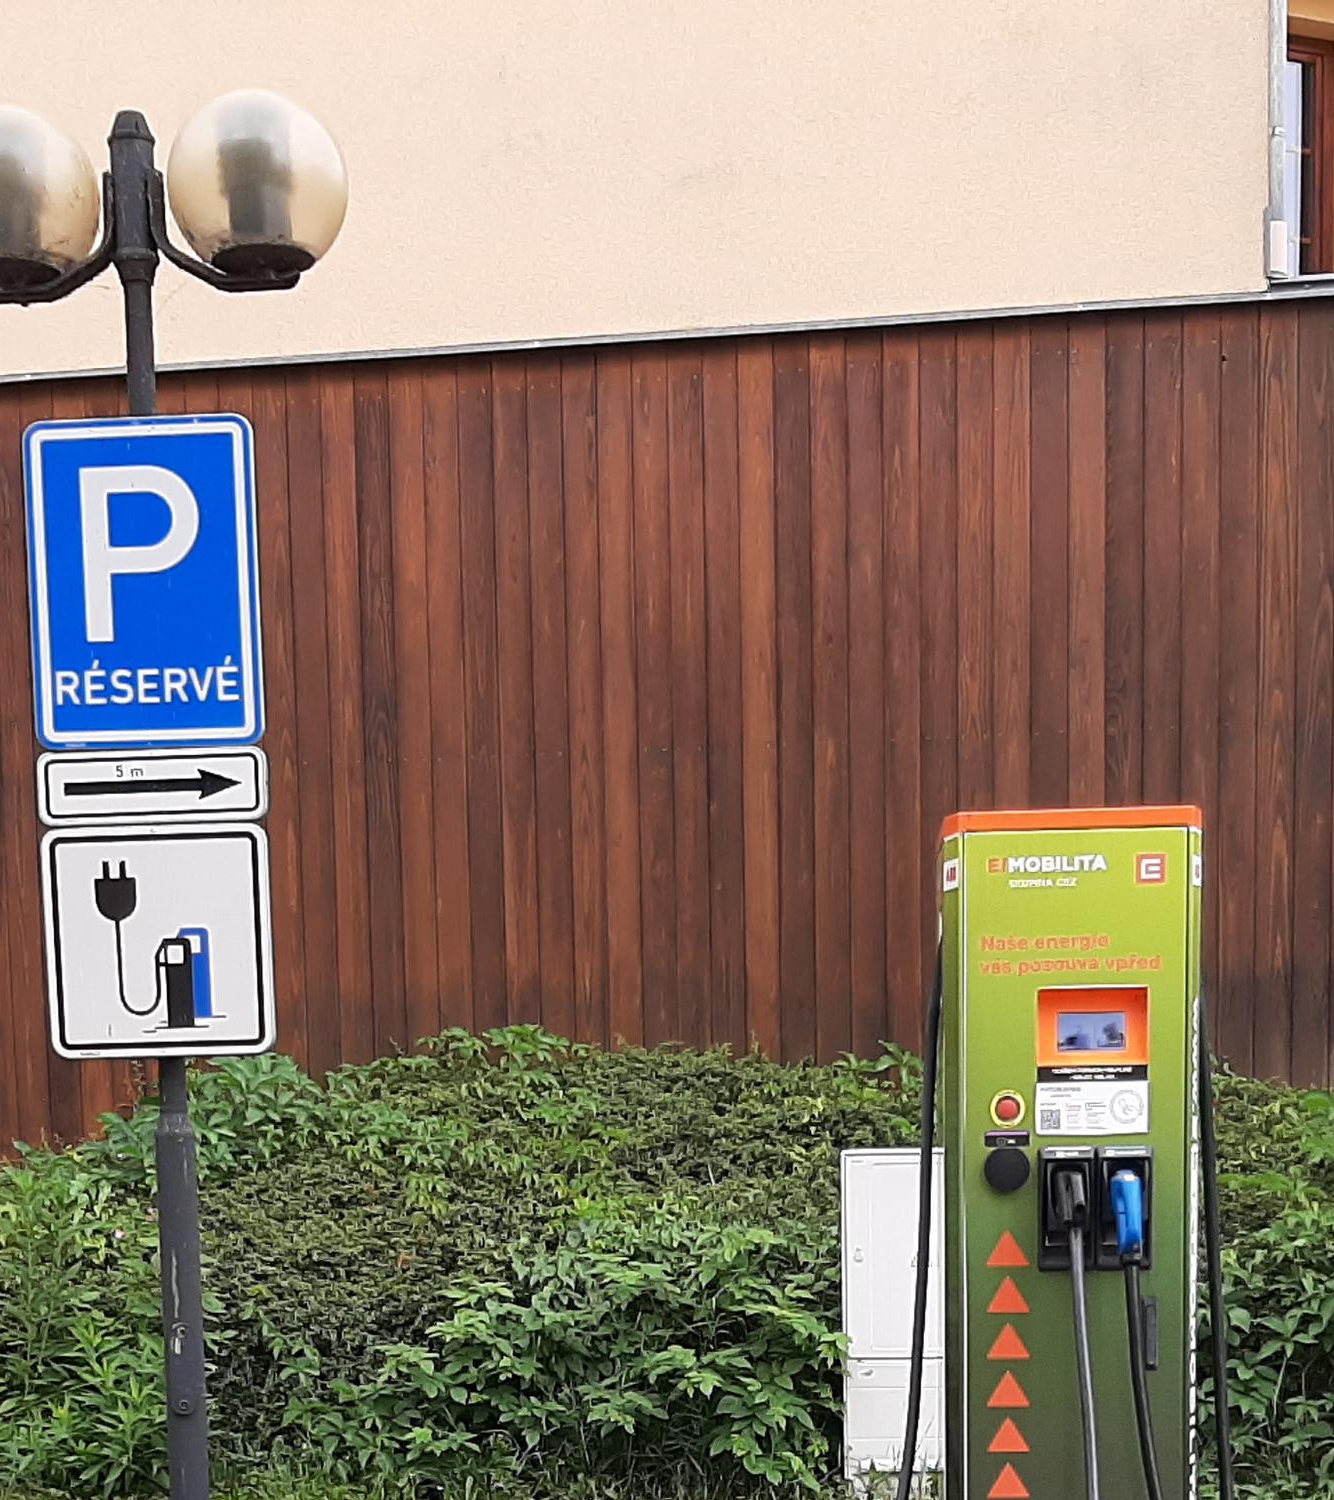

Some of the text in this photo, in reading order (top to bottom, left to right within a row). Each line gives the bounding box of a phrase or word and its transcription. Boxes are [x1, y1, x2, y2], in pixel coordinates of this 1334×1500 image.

[78, 464, 200, 643] P
[55, 655, 241, 706] RÉSERVÉ
[115, 764, 144, 778] 5 m
[1034, 932, 1110, 952] energie
